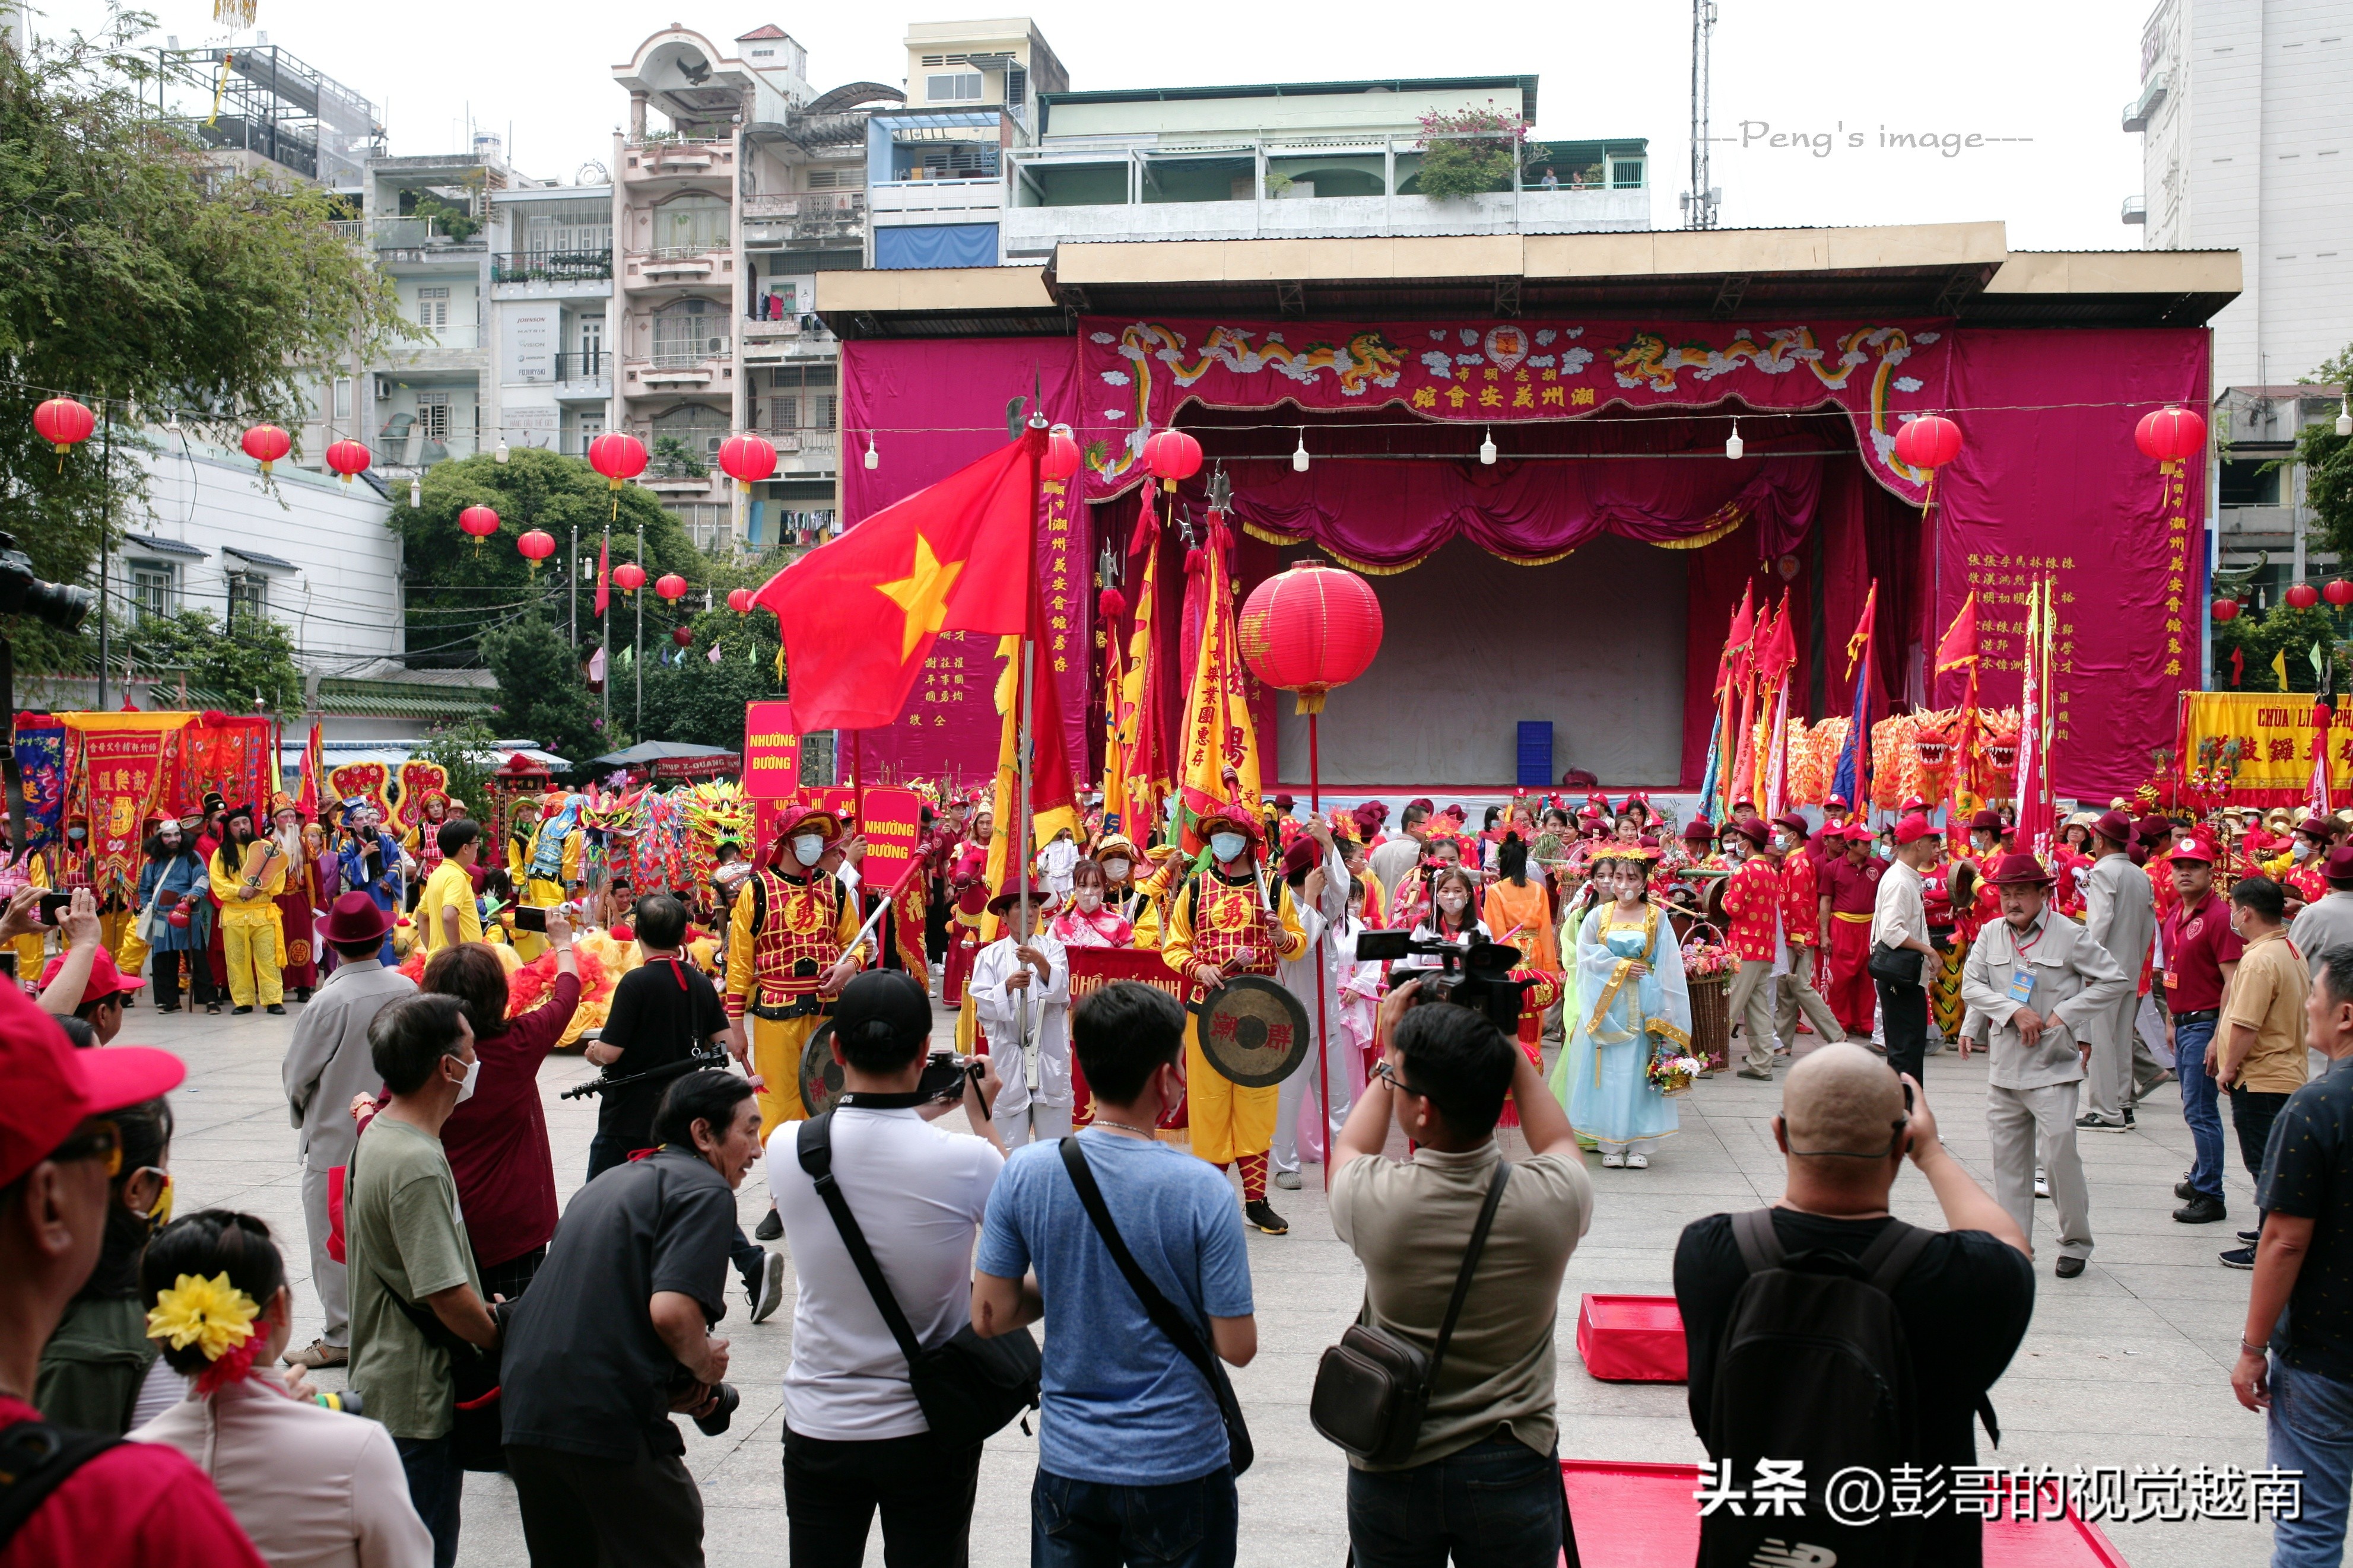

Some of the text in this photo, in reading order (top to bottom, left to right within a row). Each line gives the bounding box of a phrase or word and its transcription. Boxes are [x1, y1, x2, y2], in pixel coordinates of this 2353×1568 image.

[2257, 706, 2290, 727] CHÙA
[750, 731, 796, 747] NHƯỜNG
[752, 754, 791, 770] ĐƯỜNG
[864, 819, 914, 837] NHƯỜNG
[867, 842, 909, 860] ĐƯỜNG
[1219, 895, 1244, 930] 勇
